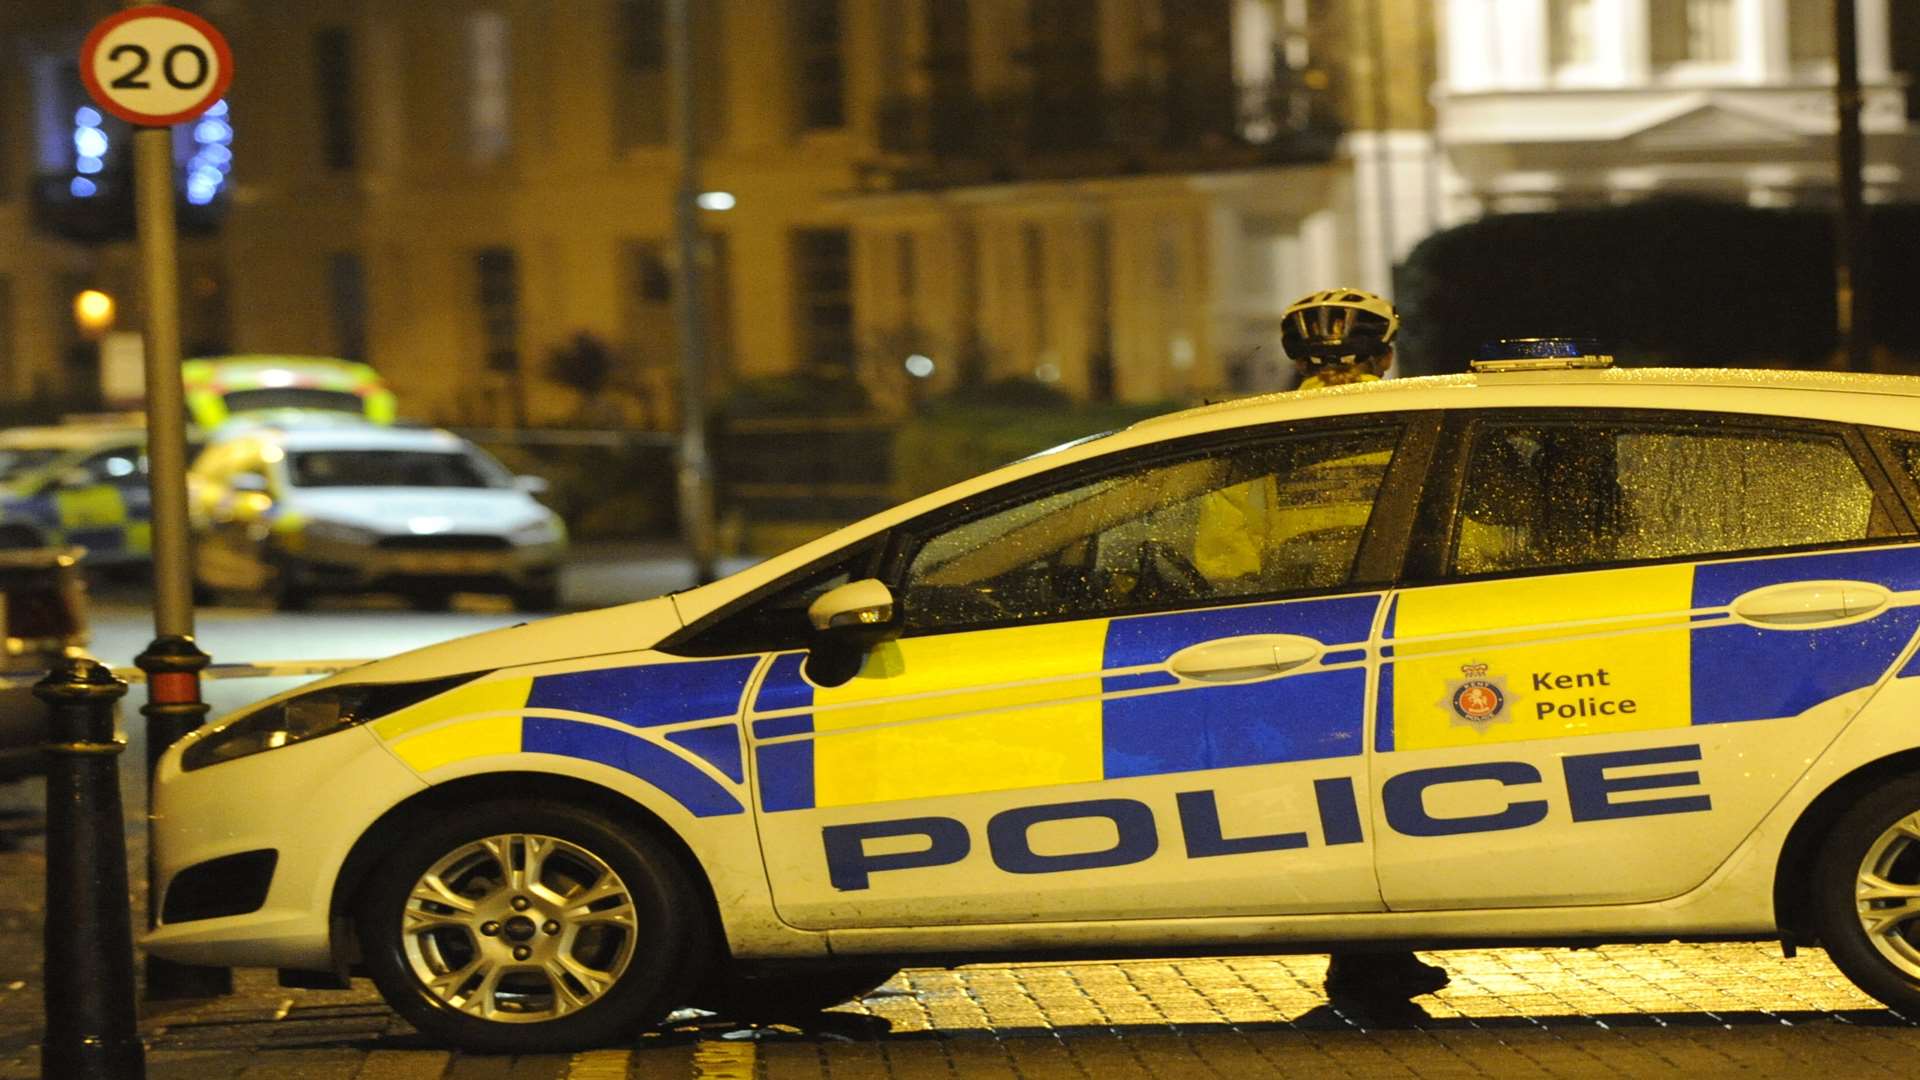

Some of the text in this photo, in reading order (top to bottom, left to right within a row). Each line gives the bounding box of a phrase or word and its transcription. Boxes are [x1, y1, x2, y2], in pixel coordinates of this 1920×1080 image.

[108, 44, 209, 90] 20
[1532, 669, 1610, 691] Kent
[1536, 698, 1637, 720] Police
[822, 744, 1711, 891] POLICE
